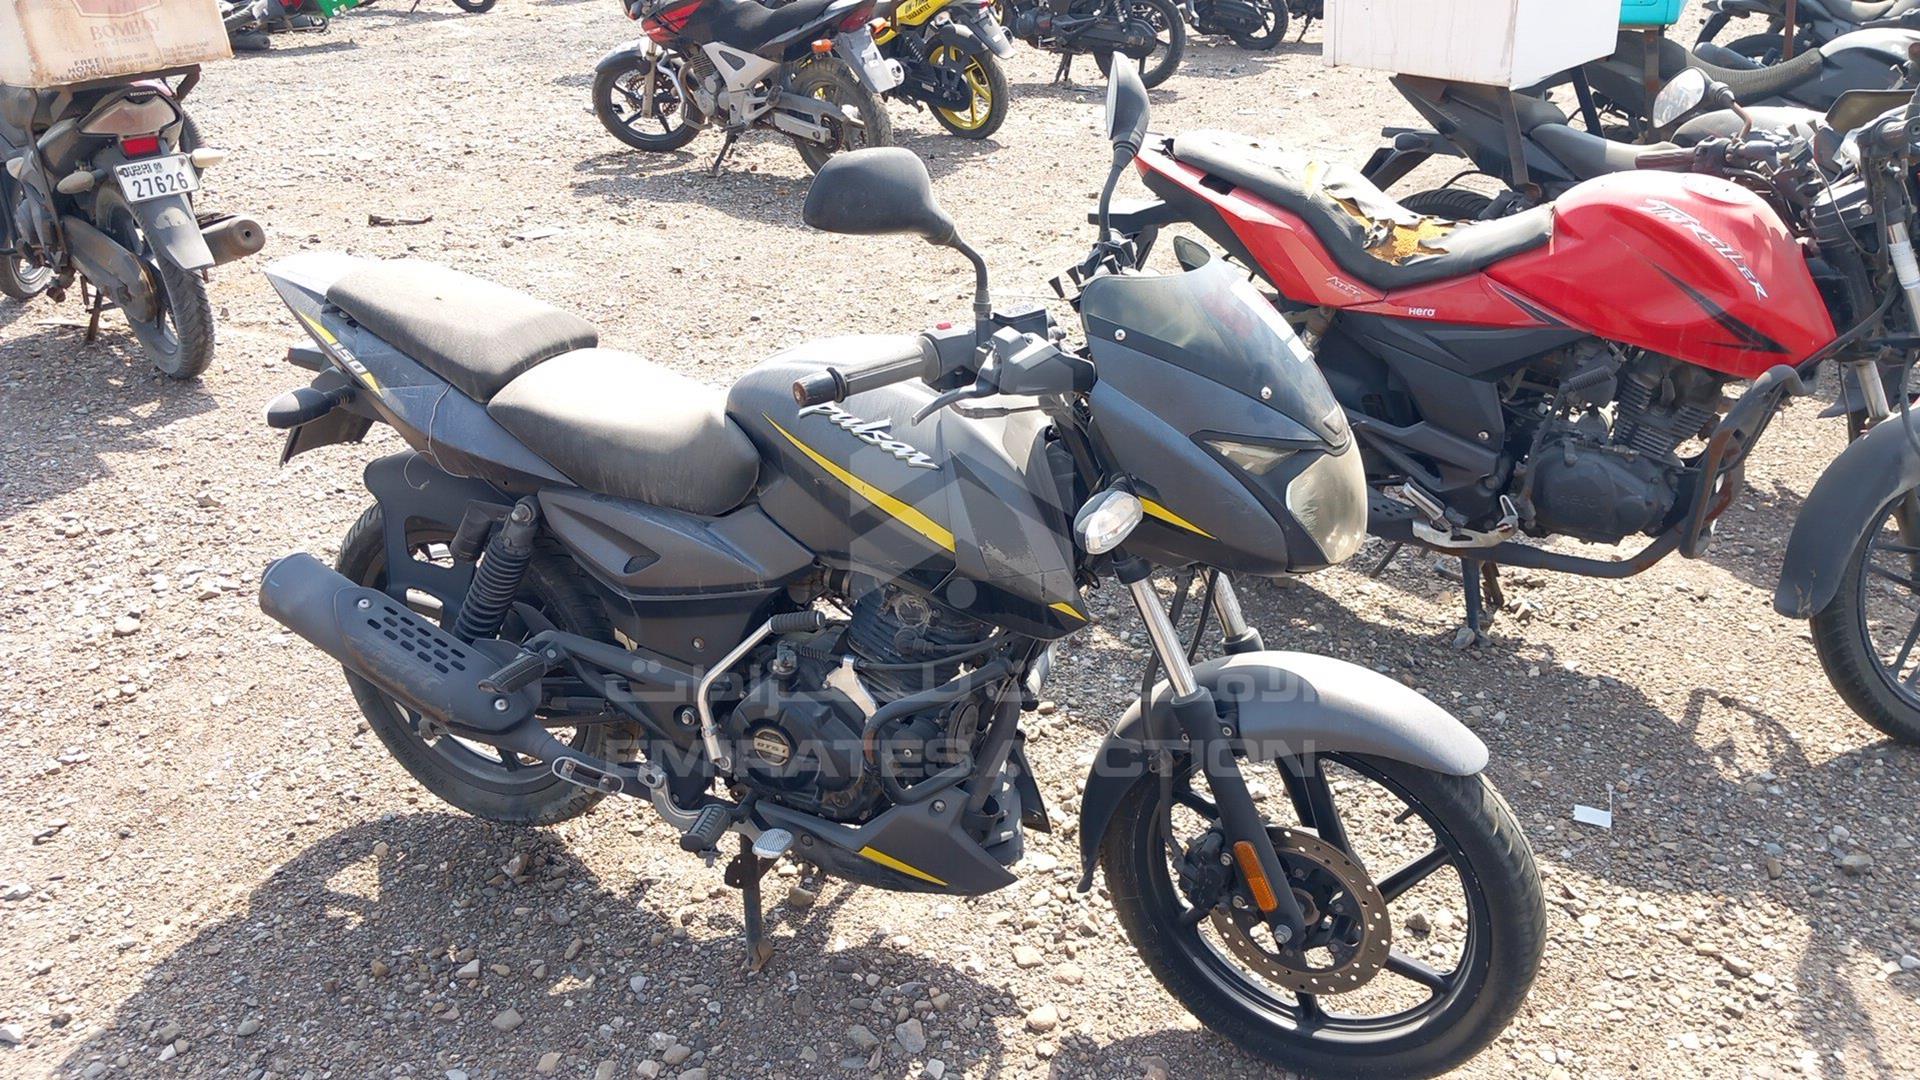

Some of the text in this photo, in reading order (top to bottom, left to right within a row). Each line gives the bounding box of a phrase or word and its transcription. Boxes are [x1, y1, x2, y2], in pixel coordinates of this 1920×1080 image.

[67, 64, 102, 74] HOME
[74, 57, 100, 66] FREE
[133, 172, 188, 198] 27626
[331, 342, 368, 374] 150
